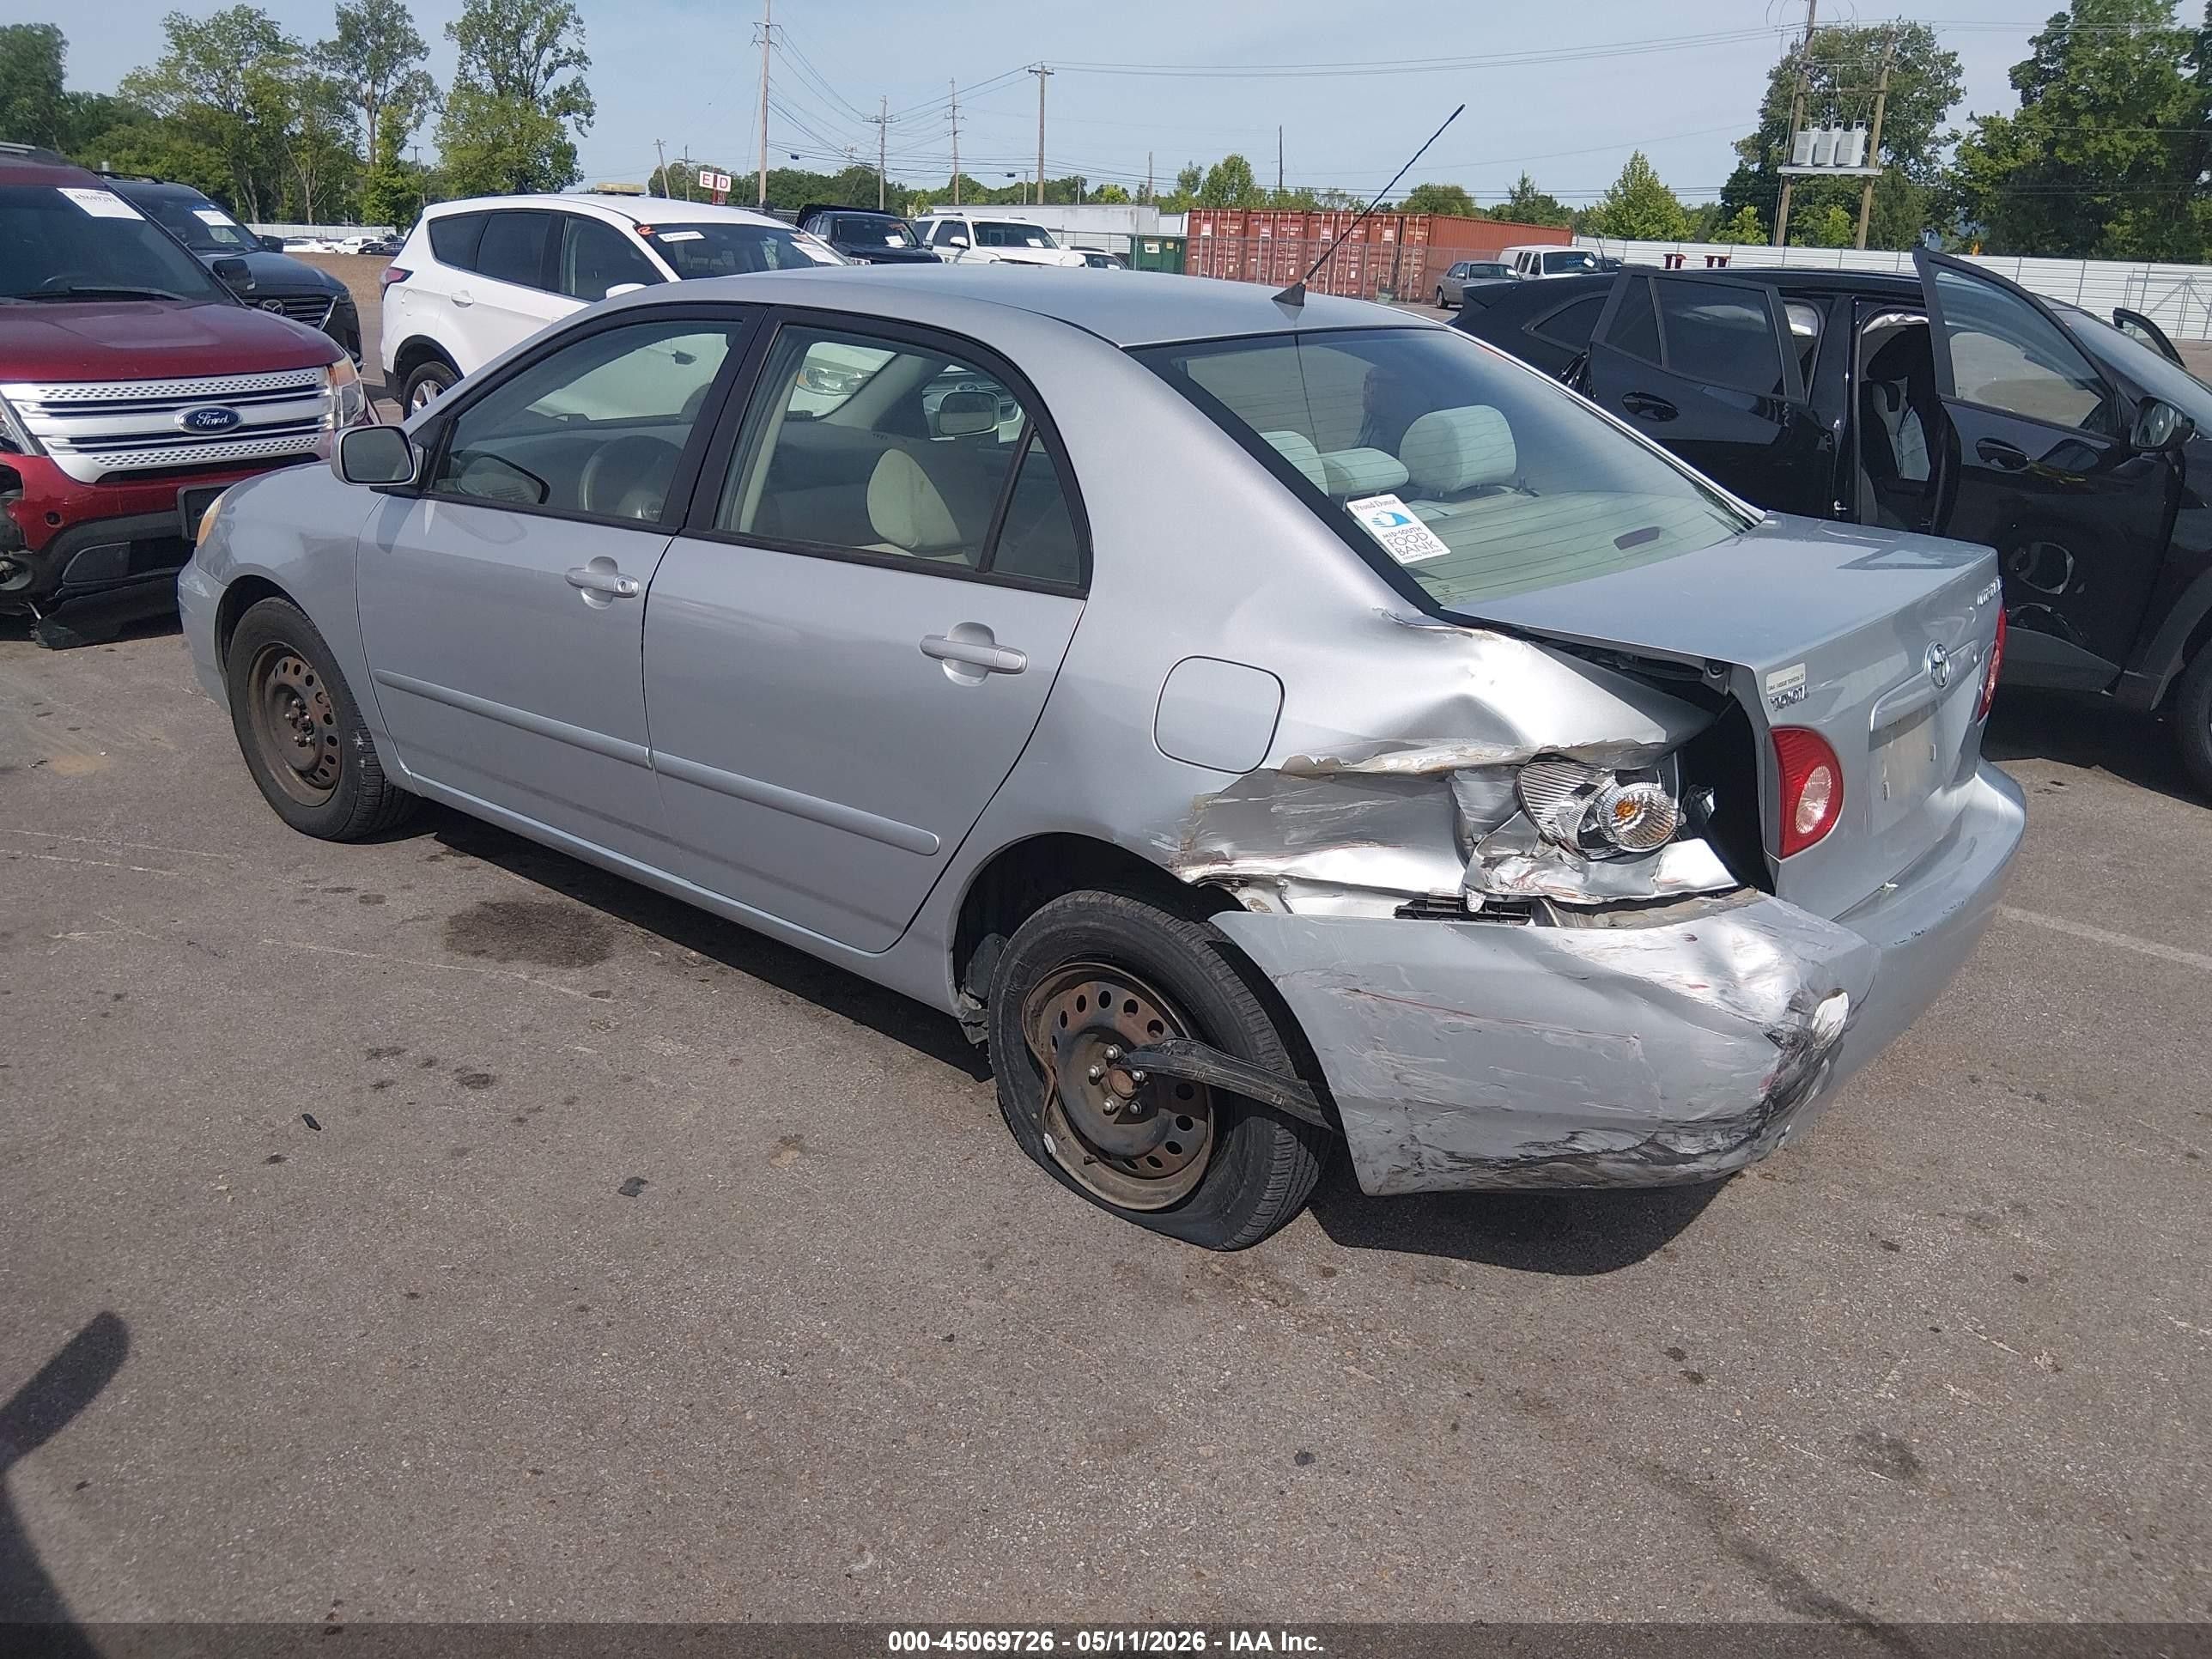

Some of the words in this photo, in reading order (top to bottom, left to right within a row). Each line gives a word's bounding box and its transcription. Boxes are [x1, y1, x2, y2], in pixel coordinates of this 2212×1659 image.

[196, 411, 230, 427] Ford
[1352, 501, 1376, 512] Proud
[1374, 499, 1397, 507] Donor
[1382, 526, 1423, 539] MID-SOUTH
[1387, 532, 1428, 548] FOOD
[1395, 540, 1439, 556] BANK
